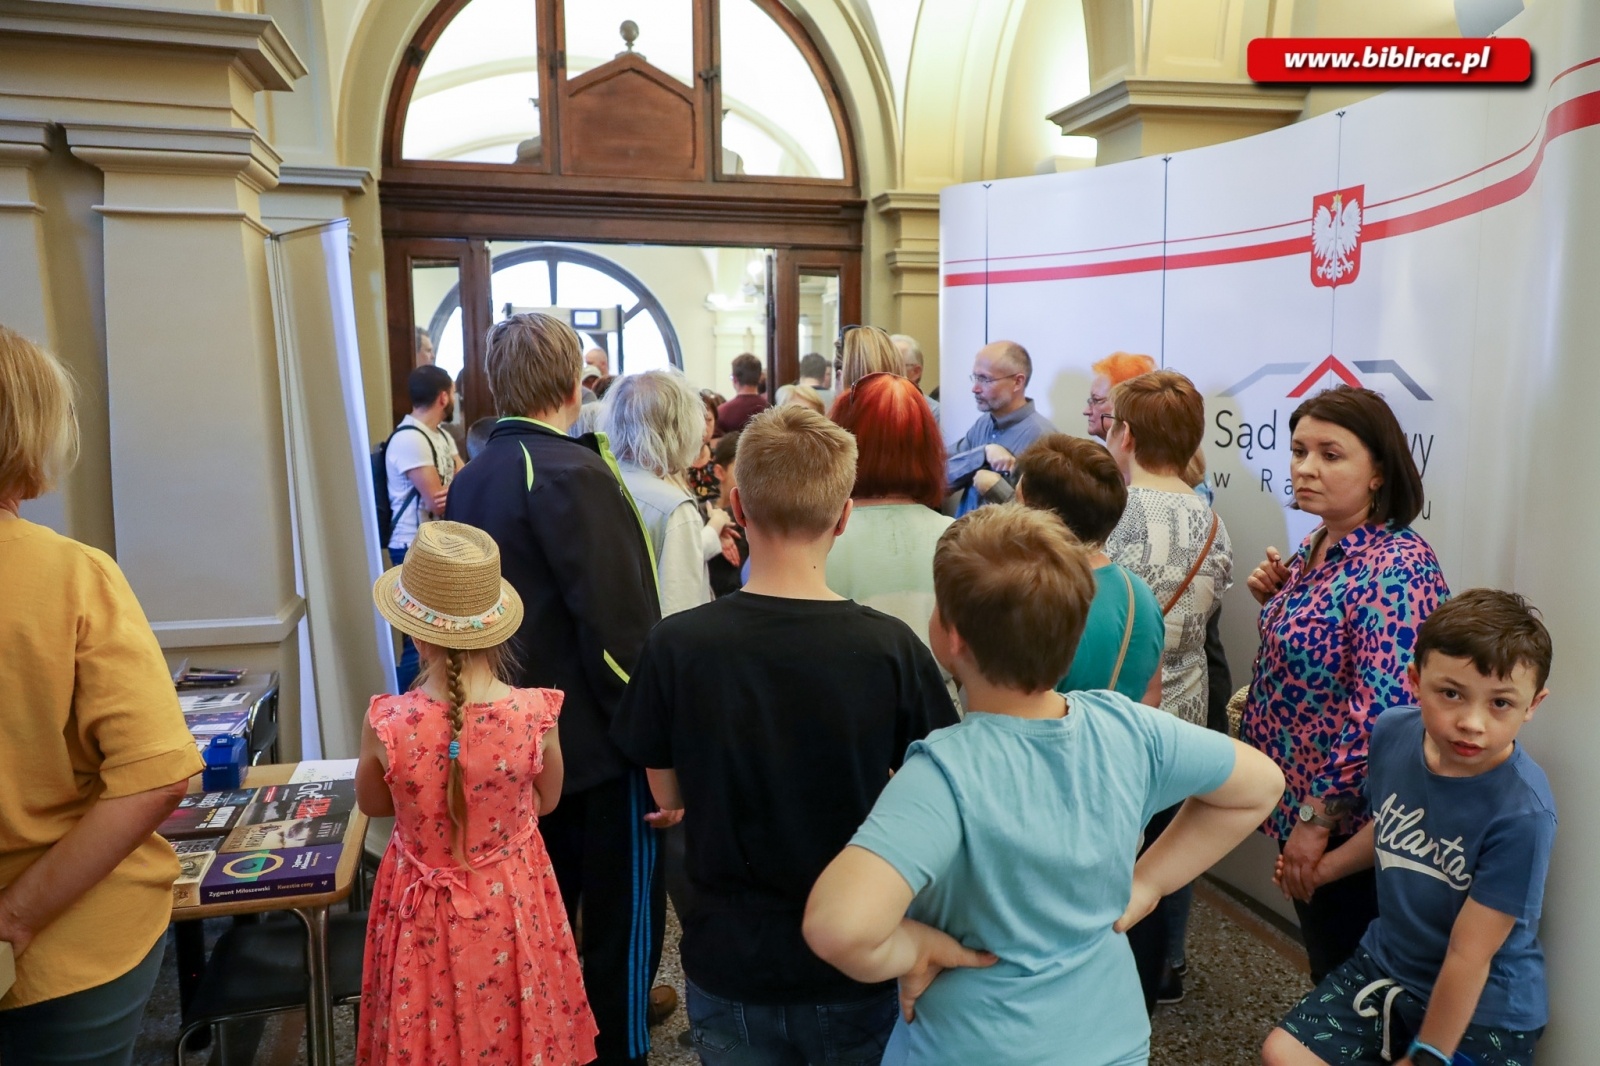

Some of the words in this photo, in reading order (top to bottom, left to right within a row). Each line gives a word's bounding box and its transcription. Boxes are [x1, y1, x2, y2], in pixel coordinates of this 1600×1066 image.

[1214, 409, 1278, 460] Sąd
[1373, 793, 1473, 882] Atlanta
[235, 886, 271, 894] Miłoszewski
